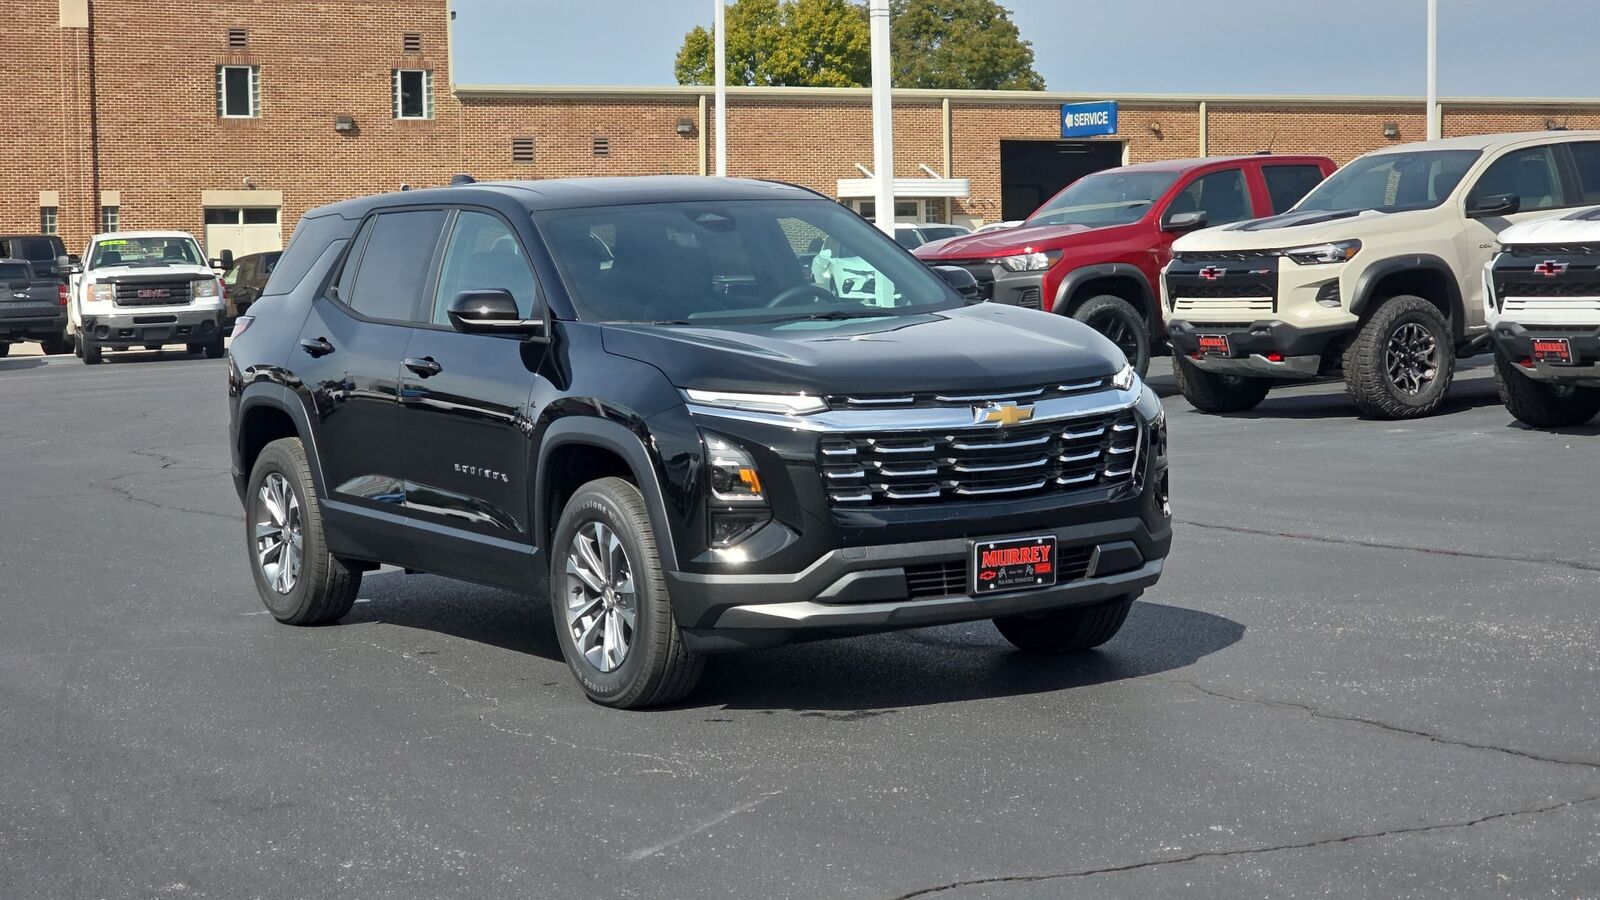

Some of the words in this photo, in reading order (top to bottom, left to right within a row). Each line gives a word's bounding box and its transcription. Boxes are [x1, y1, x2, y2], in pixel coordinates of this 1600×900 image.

[1074, 111, 1108, 126] SERVICE
[1535, 342, 1566, 351] MURREY
[982, 545, 1051, 568] MURREY
